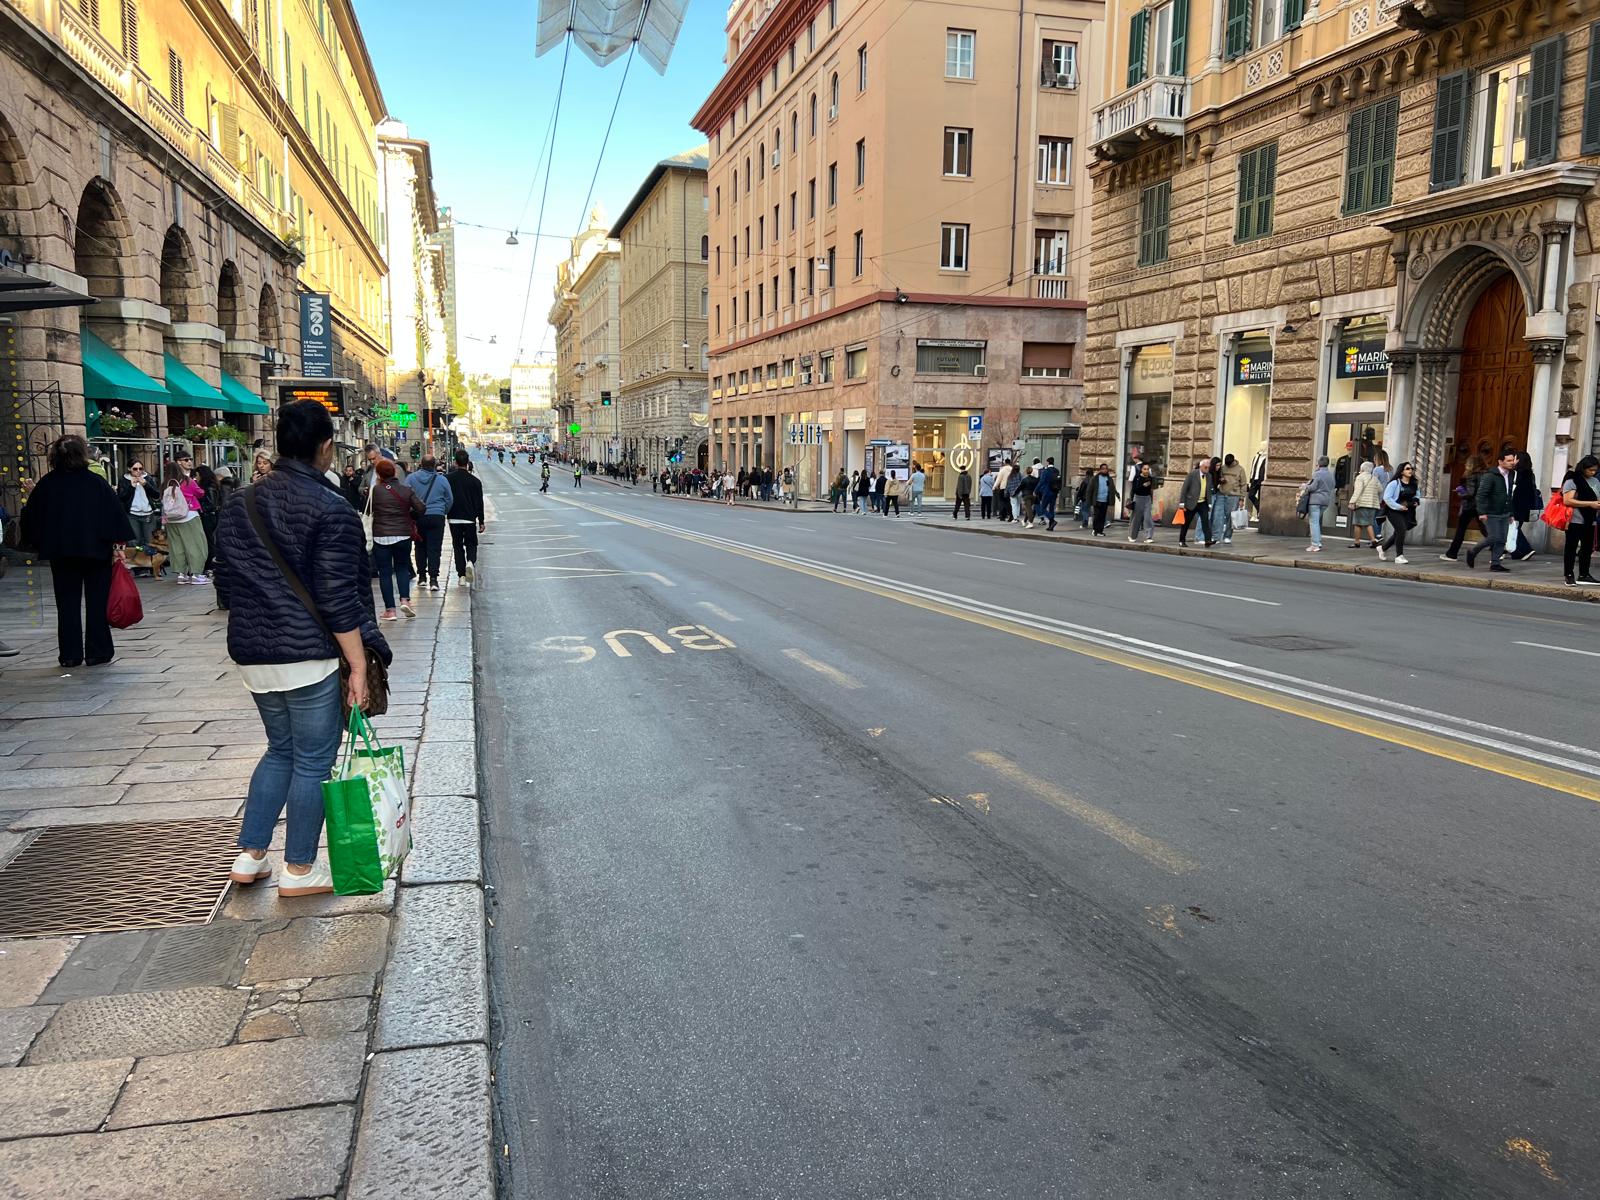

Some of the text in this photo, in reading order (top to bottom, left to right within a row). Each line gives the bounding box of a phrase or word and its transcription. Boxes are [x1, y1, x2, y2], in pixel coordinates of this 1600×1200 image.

[309, 297, 324, 336] MOG
[970, 416, 980, 429] P
[541, 624, 737, 663] BUS
